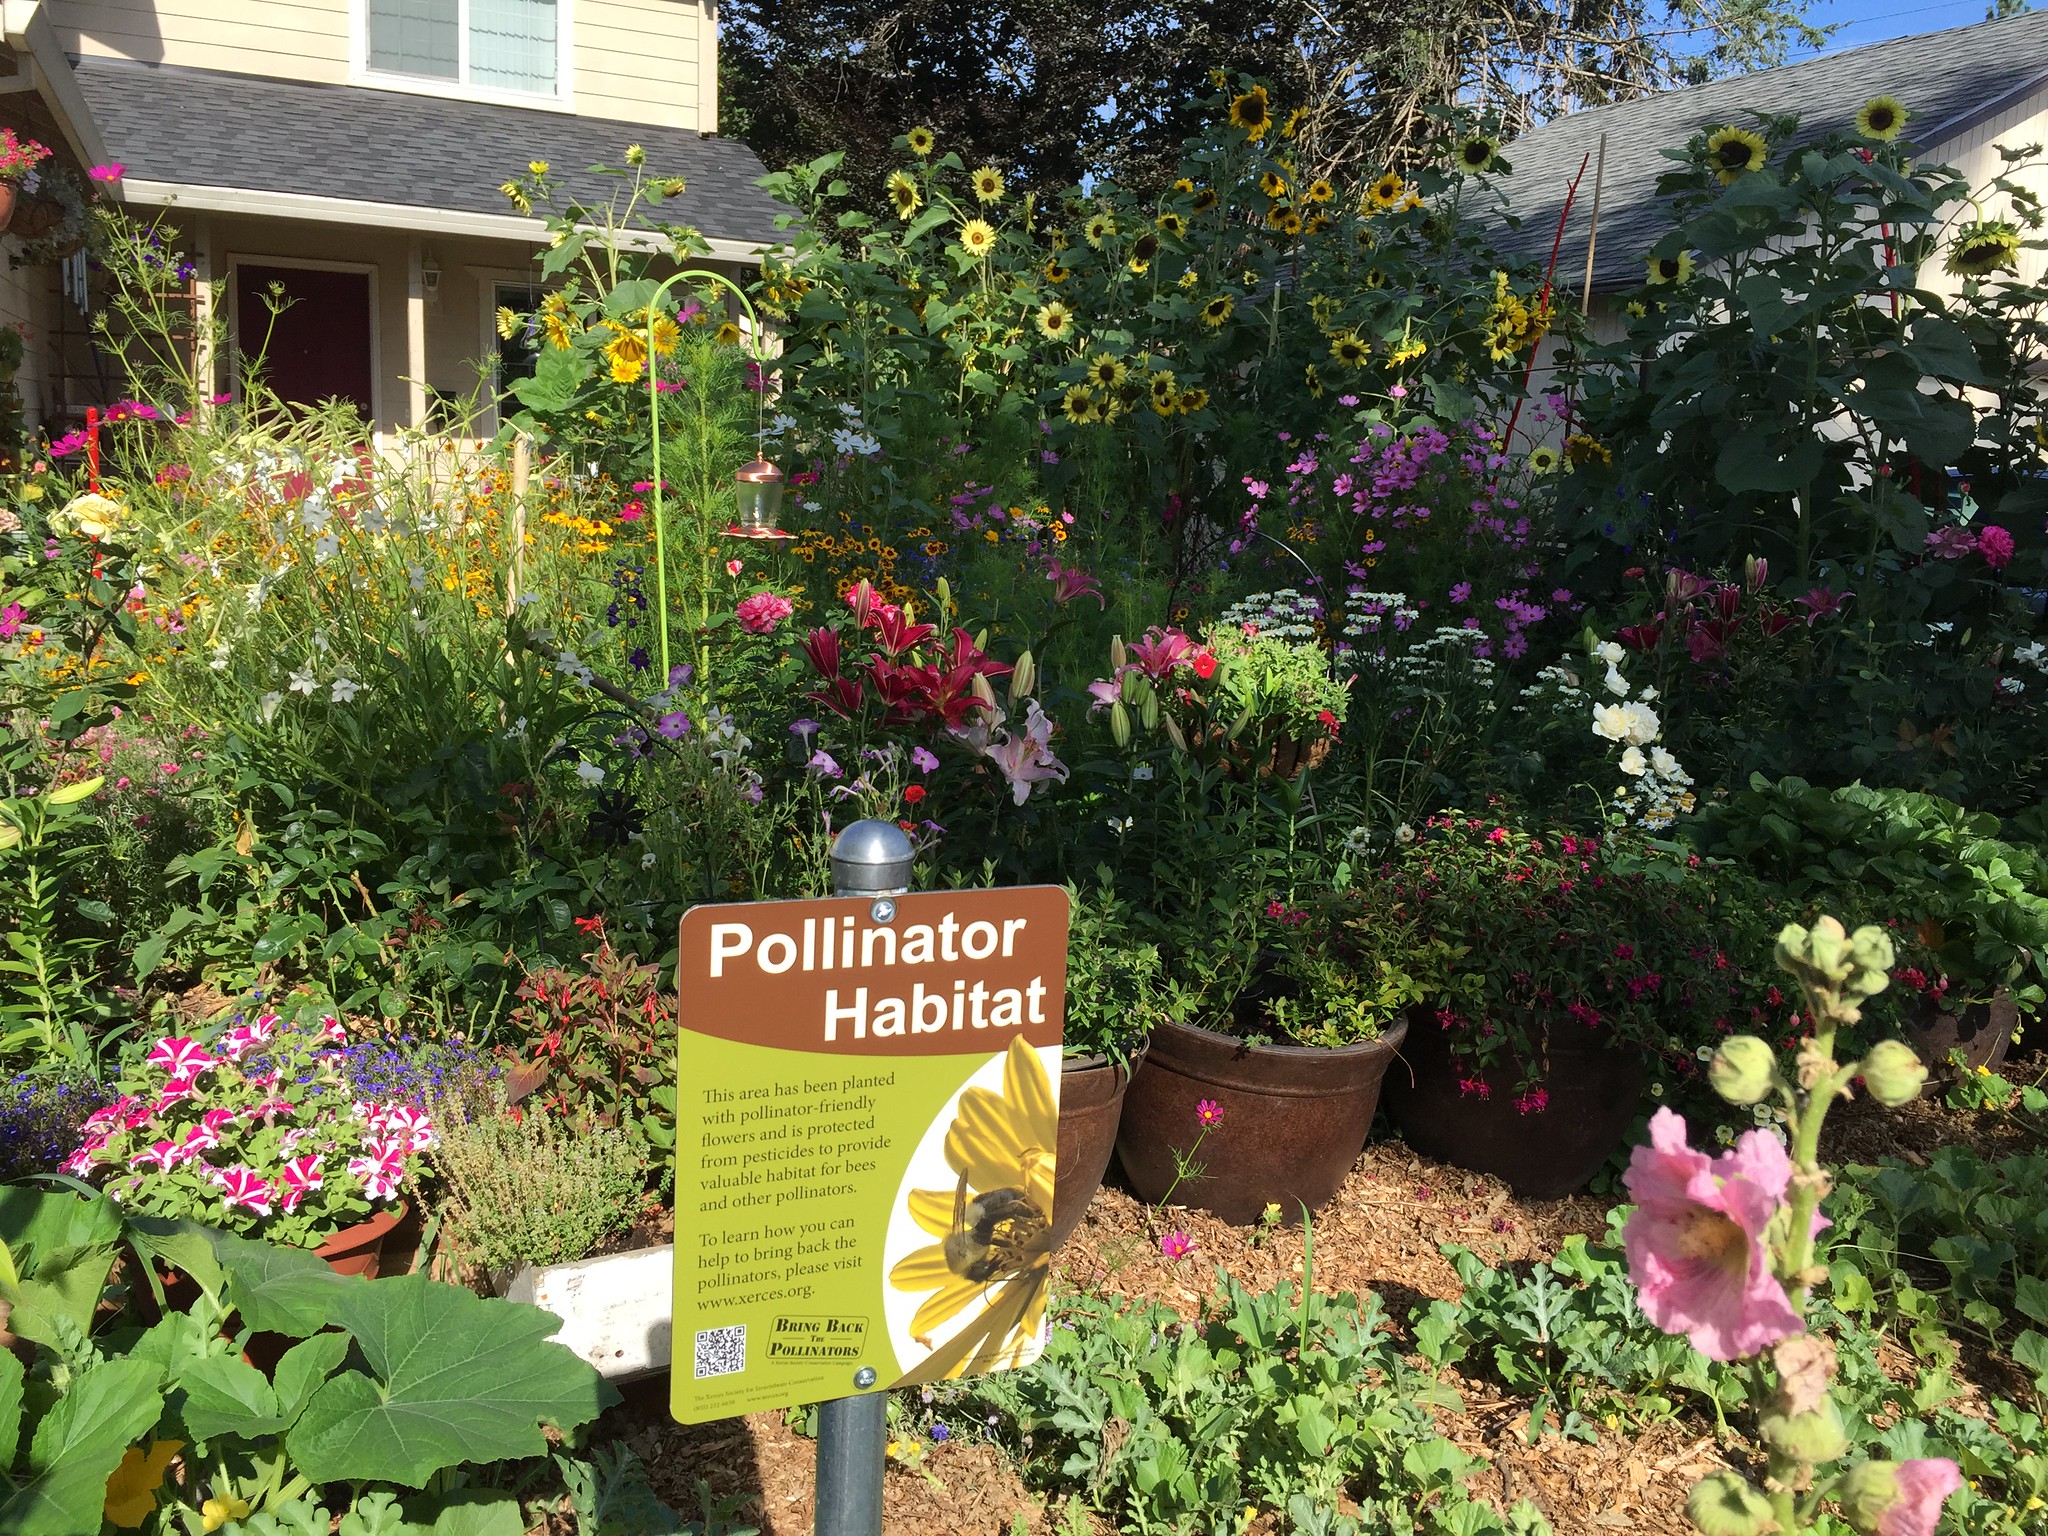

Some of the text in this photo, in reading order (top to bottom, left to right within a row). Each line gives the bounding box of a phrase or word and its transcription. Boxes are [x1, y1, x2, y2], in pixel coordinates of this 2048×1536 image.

[709, 912, 1027, 978] Pollinator
[824, 976, 1046, 1042] Habitat
[703, 1072, 895, 1103] This area has been planted
[703, 1096, 876, 1125] with pollinator-friendly
[702, 1117, 875, 1147] flowers and is protected
[701, 1135, 891, 1169] from pesticides to provide
[700, 1160, 876, 1190] valuable habitat for bees
[700, 1184, 857, 1212] and other pollinators.
[699, 1218, 855, 1247] To learn how you can
[698, 1236, 856, 1269] help to bring back the
[698, 1256, 862, 1293] pollinators, please visit
[697, 1285, 815, 1311] www.xerces.org.
[776, 1319, 863, 1332] BRING BACK
[770, 1343, 859, 1356] POLLINATORS
